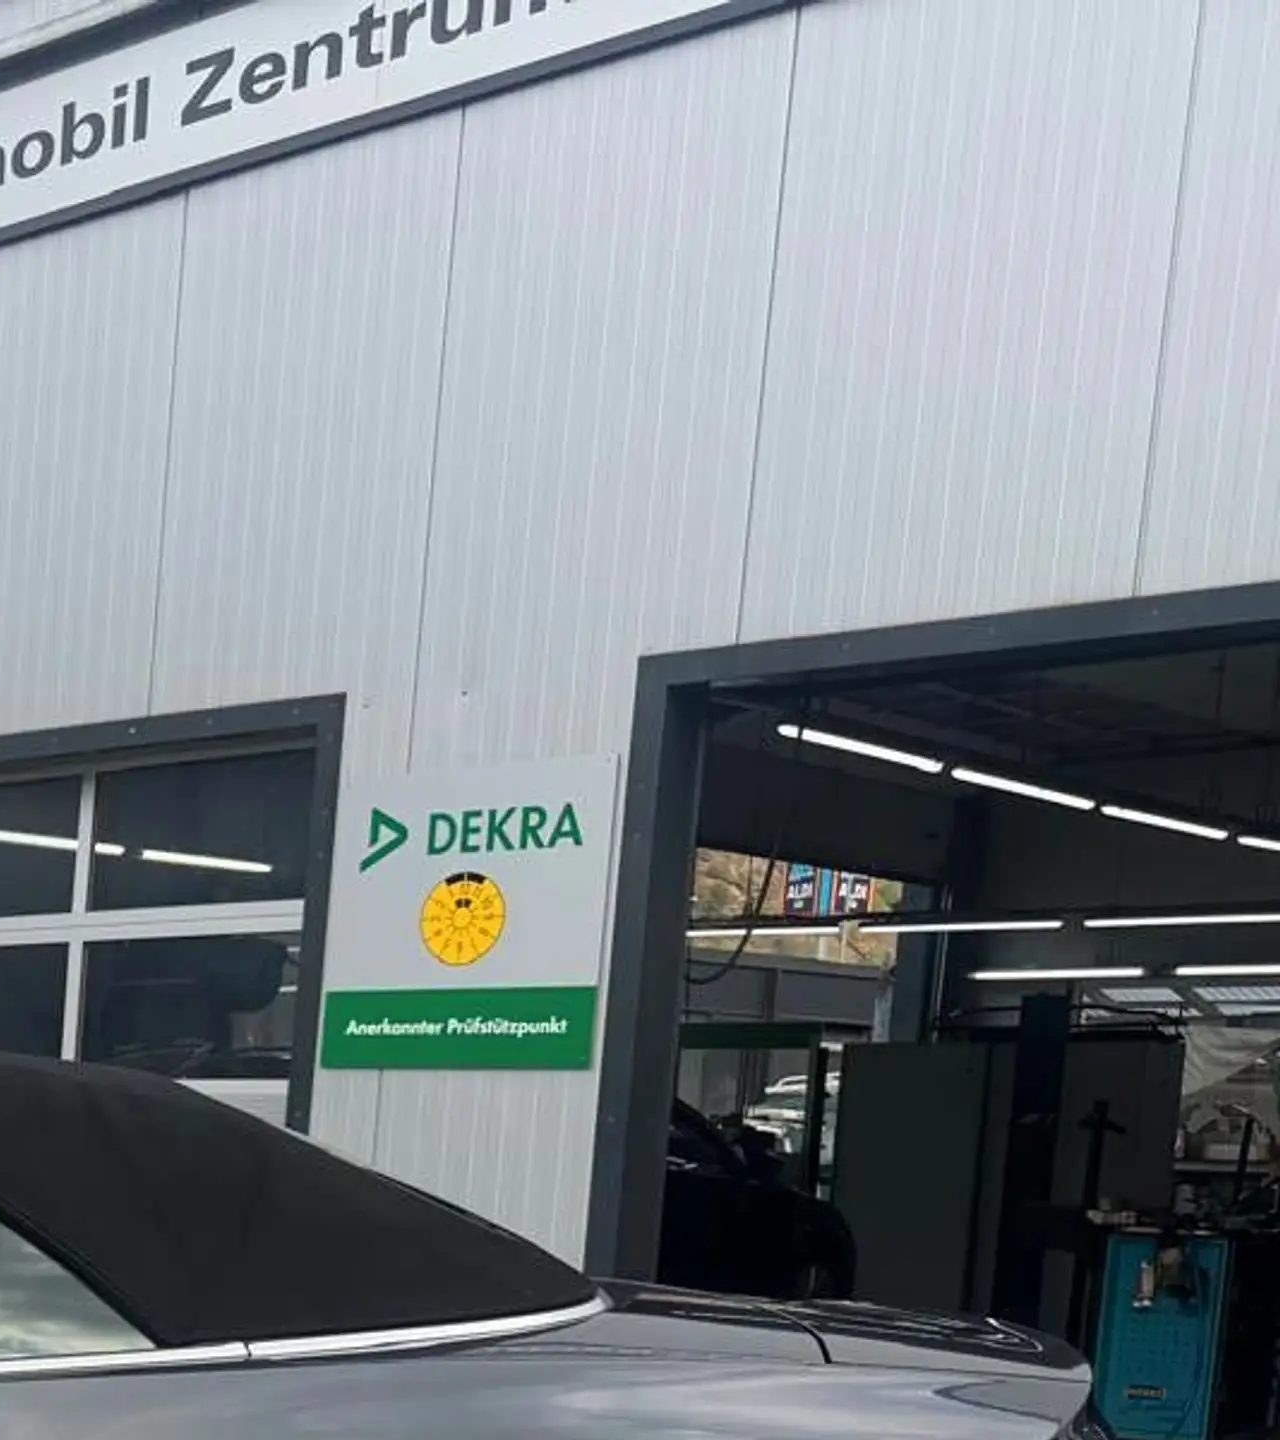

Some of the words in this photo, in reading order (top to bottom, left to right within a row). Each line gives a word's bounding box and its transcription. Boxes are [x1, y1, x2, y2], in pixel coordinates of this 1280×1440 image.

[427, 802, 583, 856] DEKRA
[346, 1018, 443, 1036] Anerkannter
[446, 1015, 568, 1038] Prüfstützpunkt
